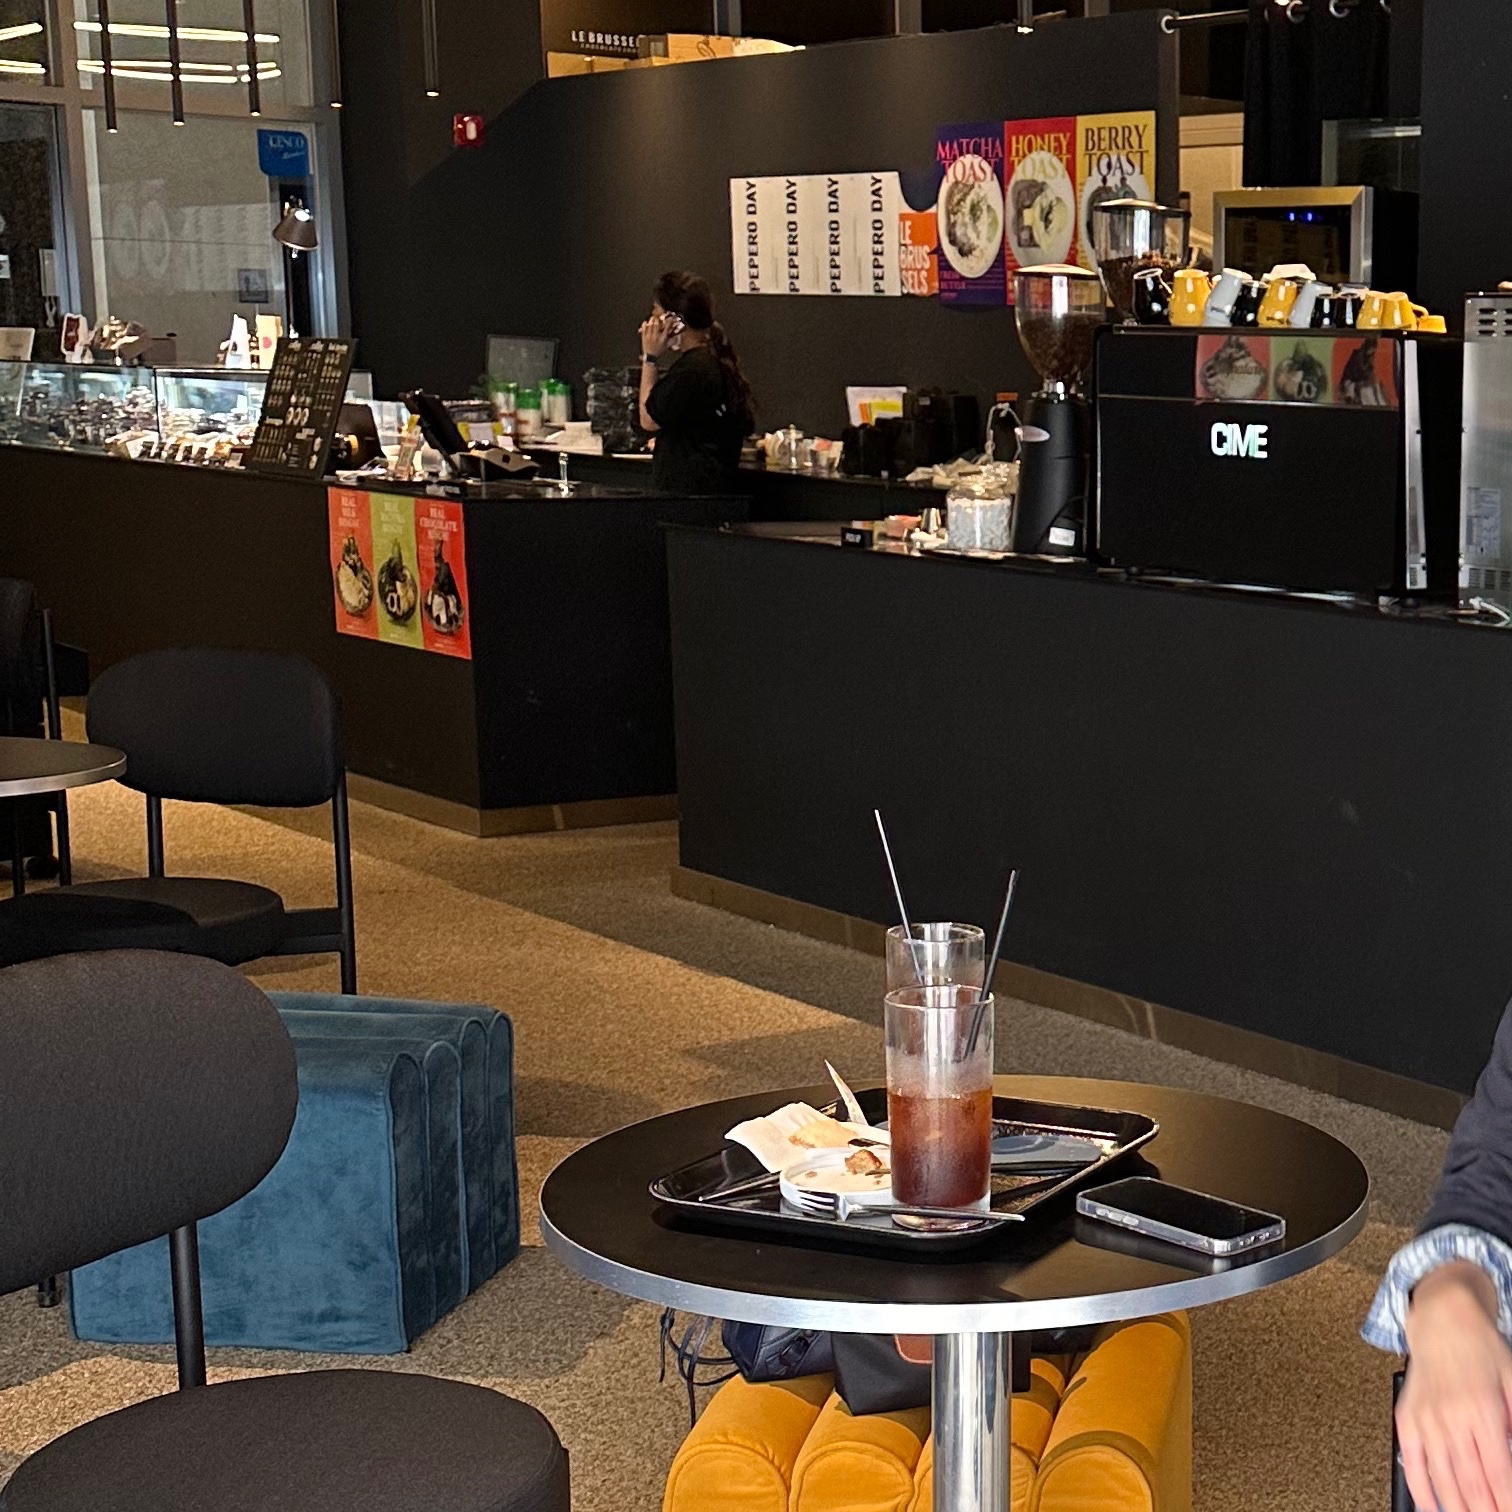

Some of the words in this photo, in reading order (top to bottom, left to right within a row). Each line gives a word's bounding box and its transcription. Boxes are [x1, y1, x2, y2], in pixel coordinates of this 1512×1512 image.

[571, 30, 585, 42] LE
[936, 137, 1003, 160] MATCHA
[1010, 132, 1071, 157] HONEY
[1085, 124, 1148, 152] BERRY
[941, 158, 1000, 183] TOAST
[1010, 154, 1071, 181] TOAST
[1084, 150, 1149, 177] TOAST
[746, 181, 757, 215] DAY
[785, 179, 797, 214] DAY
[828, 177, 839, 213] DAY
[871, 175, 883, 212] DAY
[900, 220, 912, 244] LE
[747, 221, 760, 293] PEPERO
[787, 220, 800, 293] PEPERO
[828, 220, 842, 293] PEPERO
[872, 219, 885, 294] PEPERO
[901, 270, 928, 294] SELS
[1210, 422, 1269, 459] CIME
